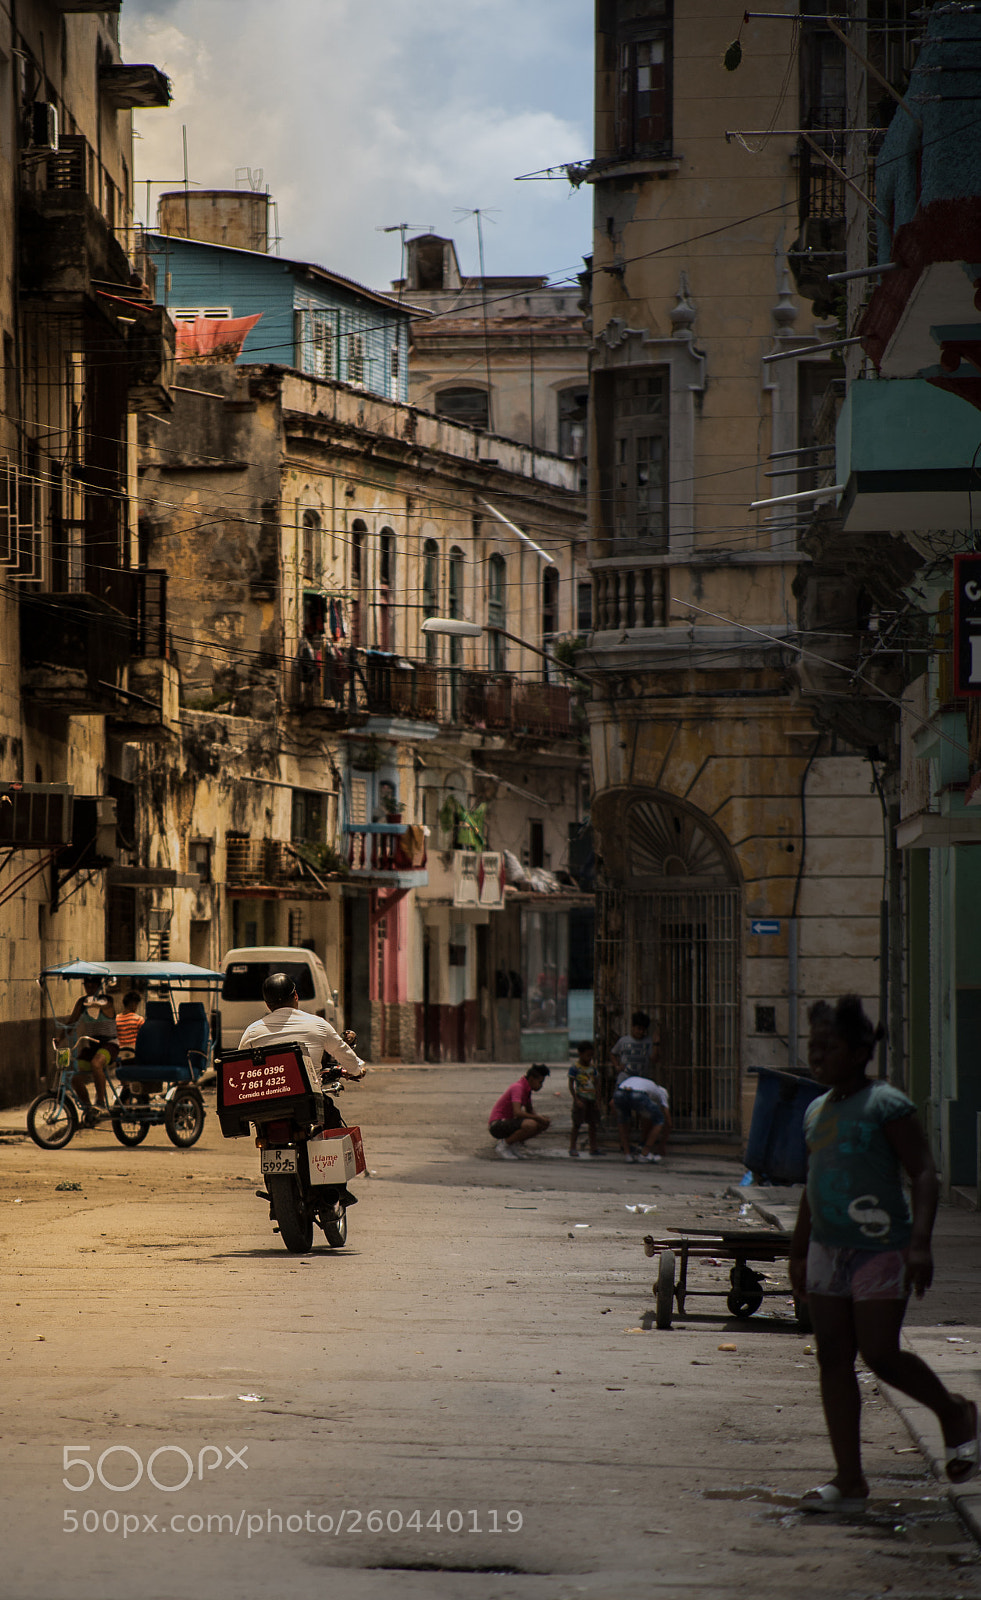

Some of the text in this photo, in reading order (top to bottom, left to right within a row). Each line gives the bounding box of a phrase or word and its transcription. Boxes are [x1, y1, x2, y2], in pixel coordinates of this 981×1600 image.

[240, 1065, 284, 1080] 7 866 0396
[241, 1077, 286, 1091] 7 861 4325
[239, 1091, 260, 1100] Comida
[266, 1086, 291, 1095] domicilio
[275, 1150, 282, 1160] R
[263, 1161, 295, 1172] 59925
[323, 1160, 335, 1168] ya!
[848, 1195, 891, 1237] S
